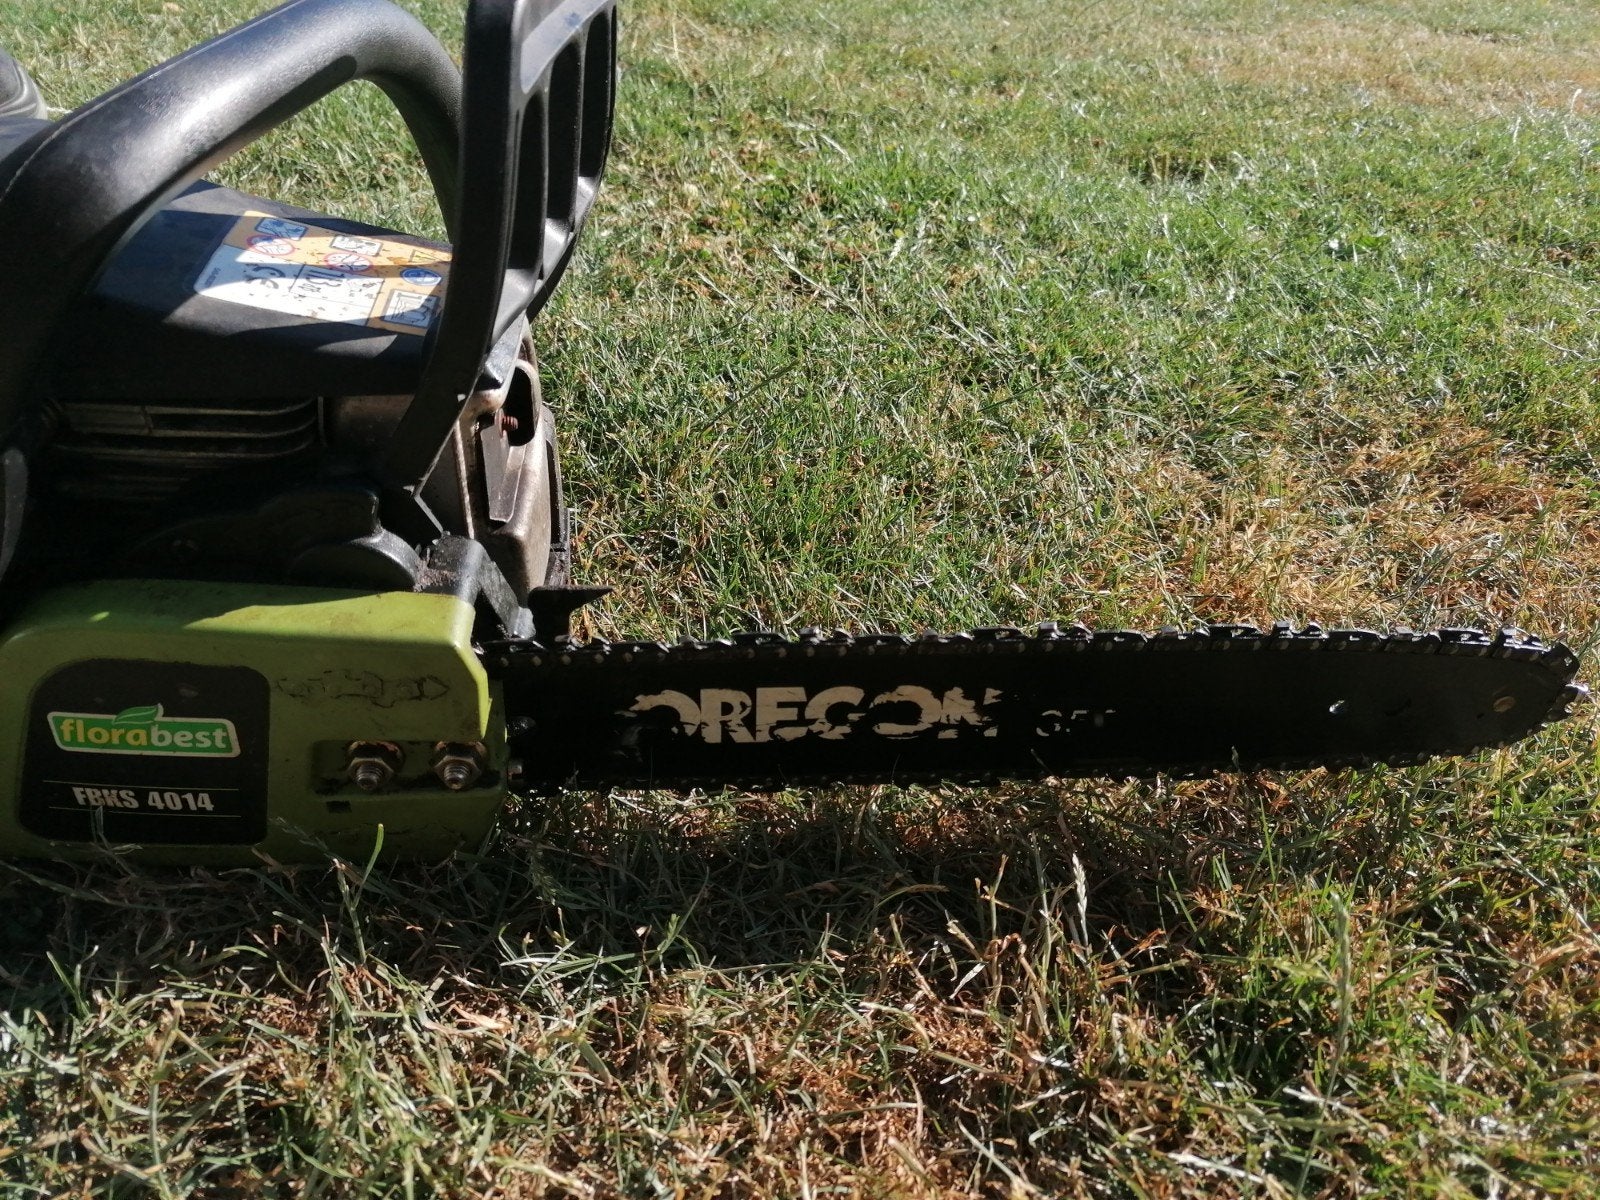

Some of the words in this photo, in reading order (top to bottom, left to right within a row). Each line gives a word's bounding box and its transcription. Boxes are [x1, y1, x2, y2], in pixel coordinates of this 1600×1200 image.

[615, 685, 1003, 744] OREGON
[60, 718, 228, 749] florabest
[72, 786, 140, 809] FBKS
[148, 791, 214, 811] 4014
